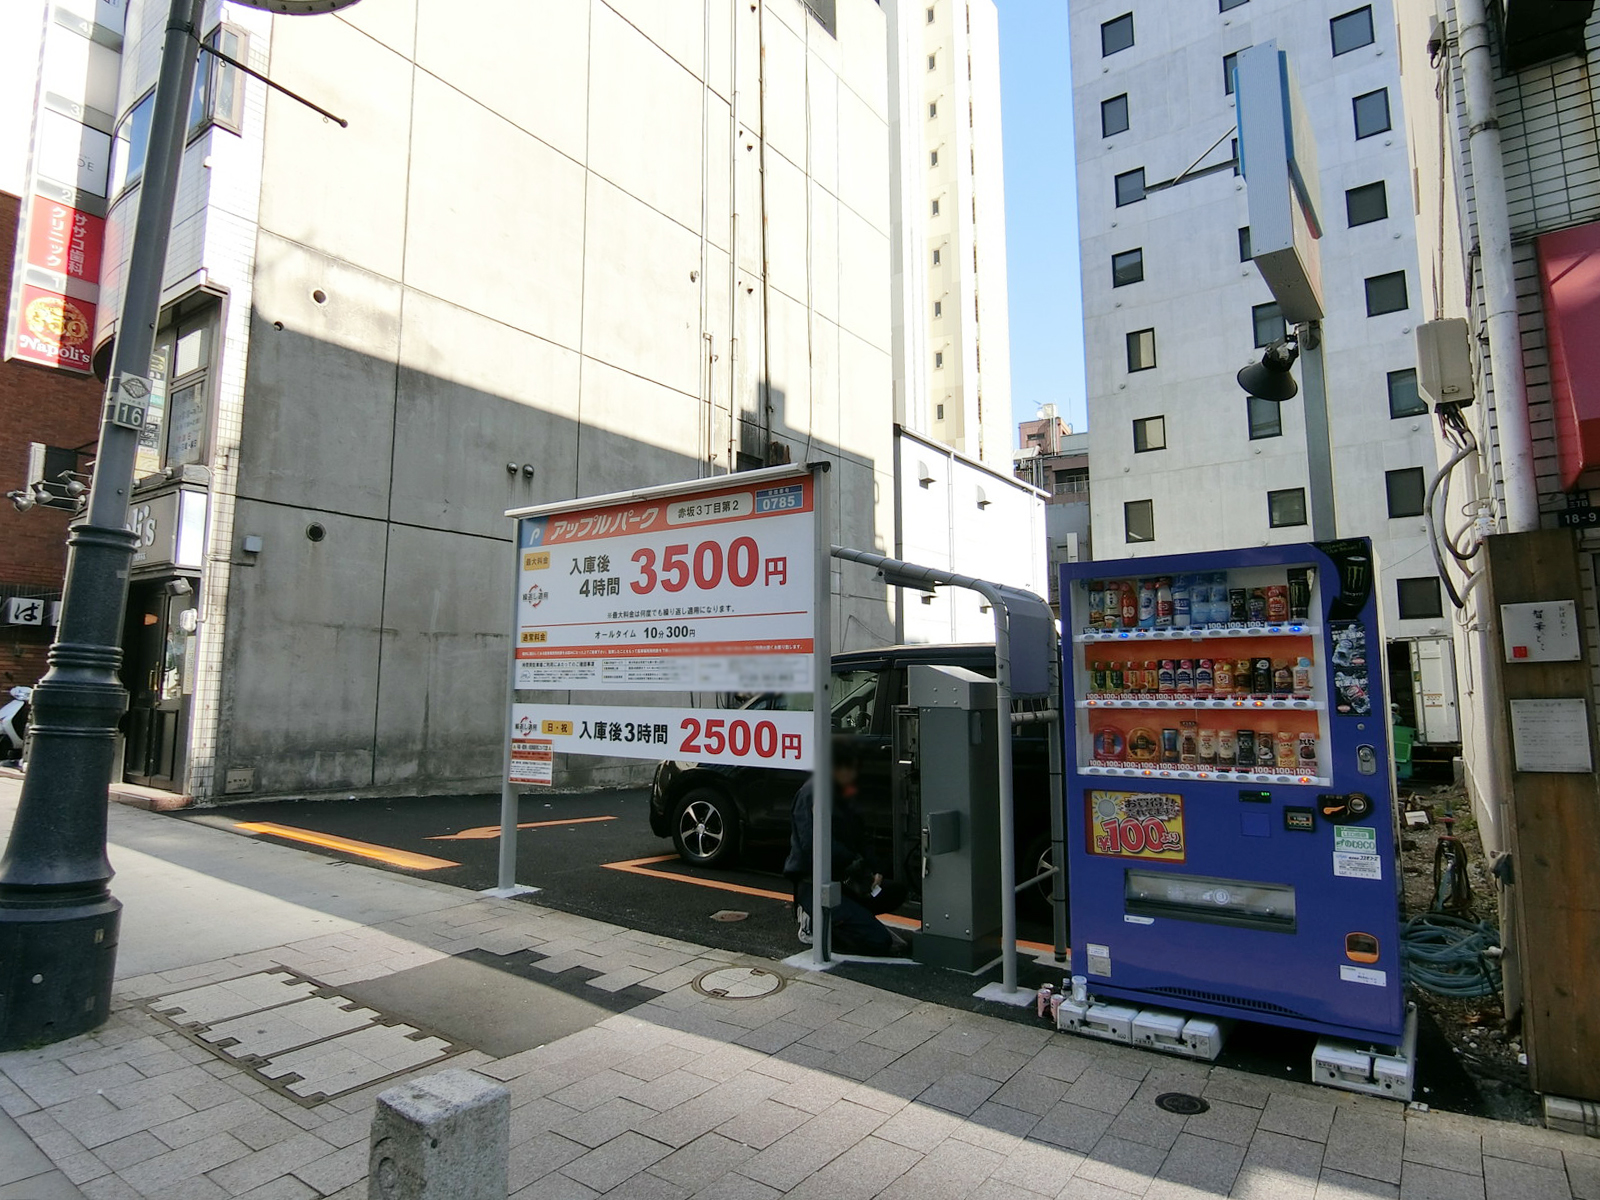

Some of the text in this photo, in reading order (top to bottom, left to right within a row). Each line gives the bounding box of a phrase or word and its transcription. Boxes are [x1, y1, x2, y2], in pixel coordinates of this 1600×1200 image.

[46, 206, 67, 267] クリニック
[19, 334, 91, 363] Napoli's
[121, 405, 142, 426] 16
[677, 500, 739, 519] 赤坂3丁目第2
[762, 495, 796, 511] 0785
[550, 508, 659, 541] アップルパーク
[1564, 512, 1597, 524] 18-9
[525, 556, 549, 567] 最大料金
[569, 554, 611, 576] 入庫後
[629, 536, 788, 595] 3500円
[579, 576, 621, 598] 4時間
[594, 629, 636, 640] オールタイム
[548, 722, 568, 733] 日・祝
[579, 720, 669, 745] 入庫後3時間
[679, 717, 803, 760] 2500円
